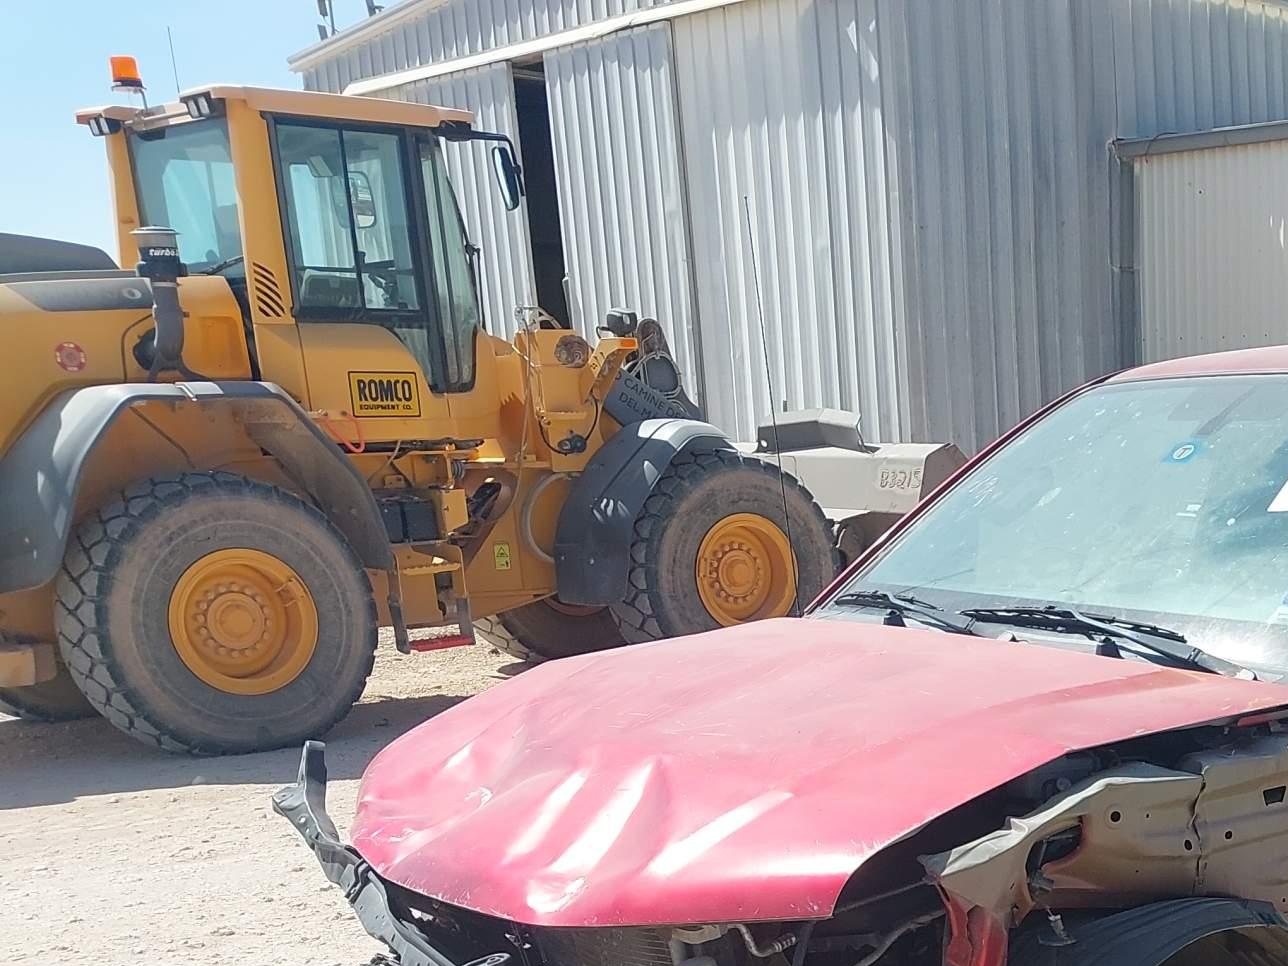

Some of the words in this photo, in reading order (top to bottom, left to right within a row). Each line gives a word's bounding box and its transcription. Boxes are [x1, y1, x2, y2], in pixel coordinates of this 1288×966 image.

[357, 379, 413, 402] ROMCO
[618, 391, 640, 413] DEL
[624, 377, 665, 410] CAMINE
